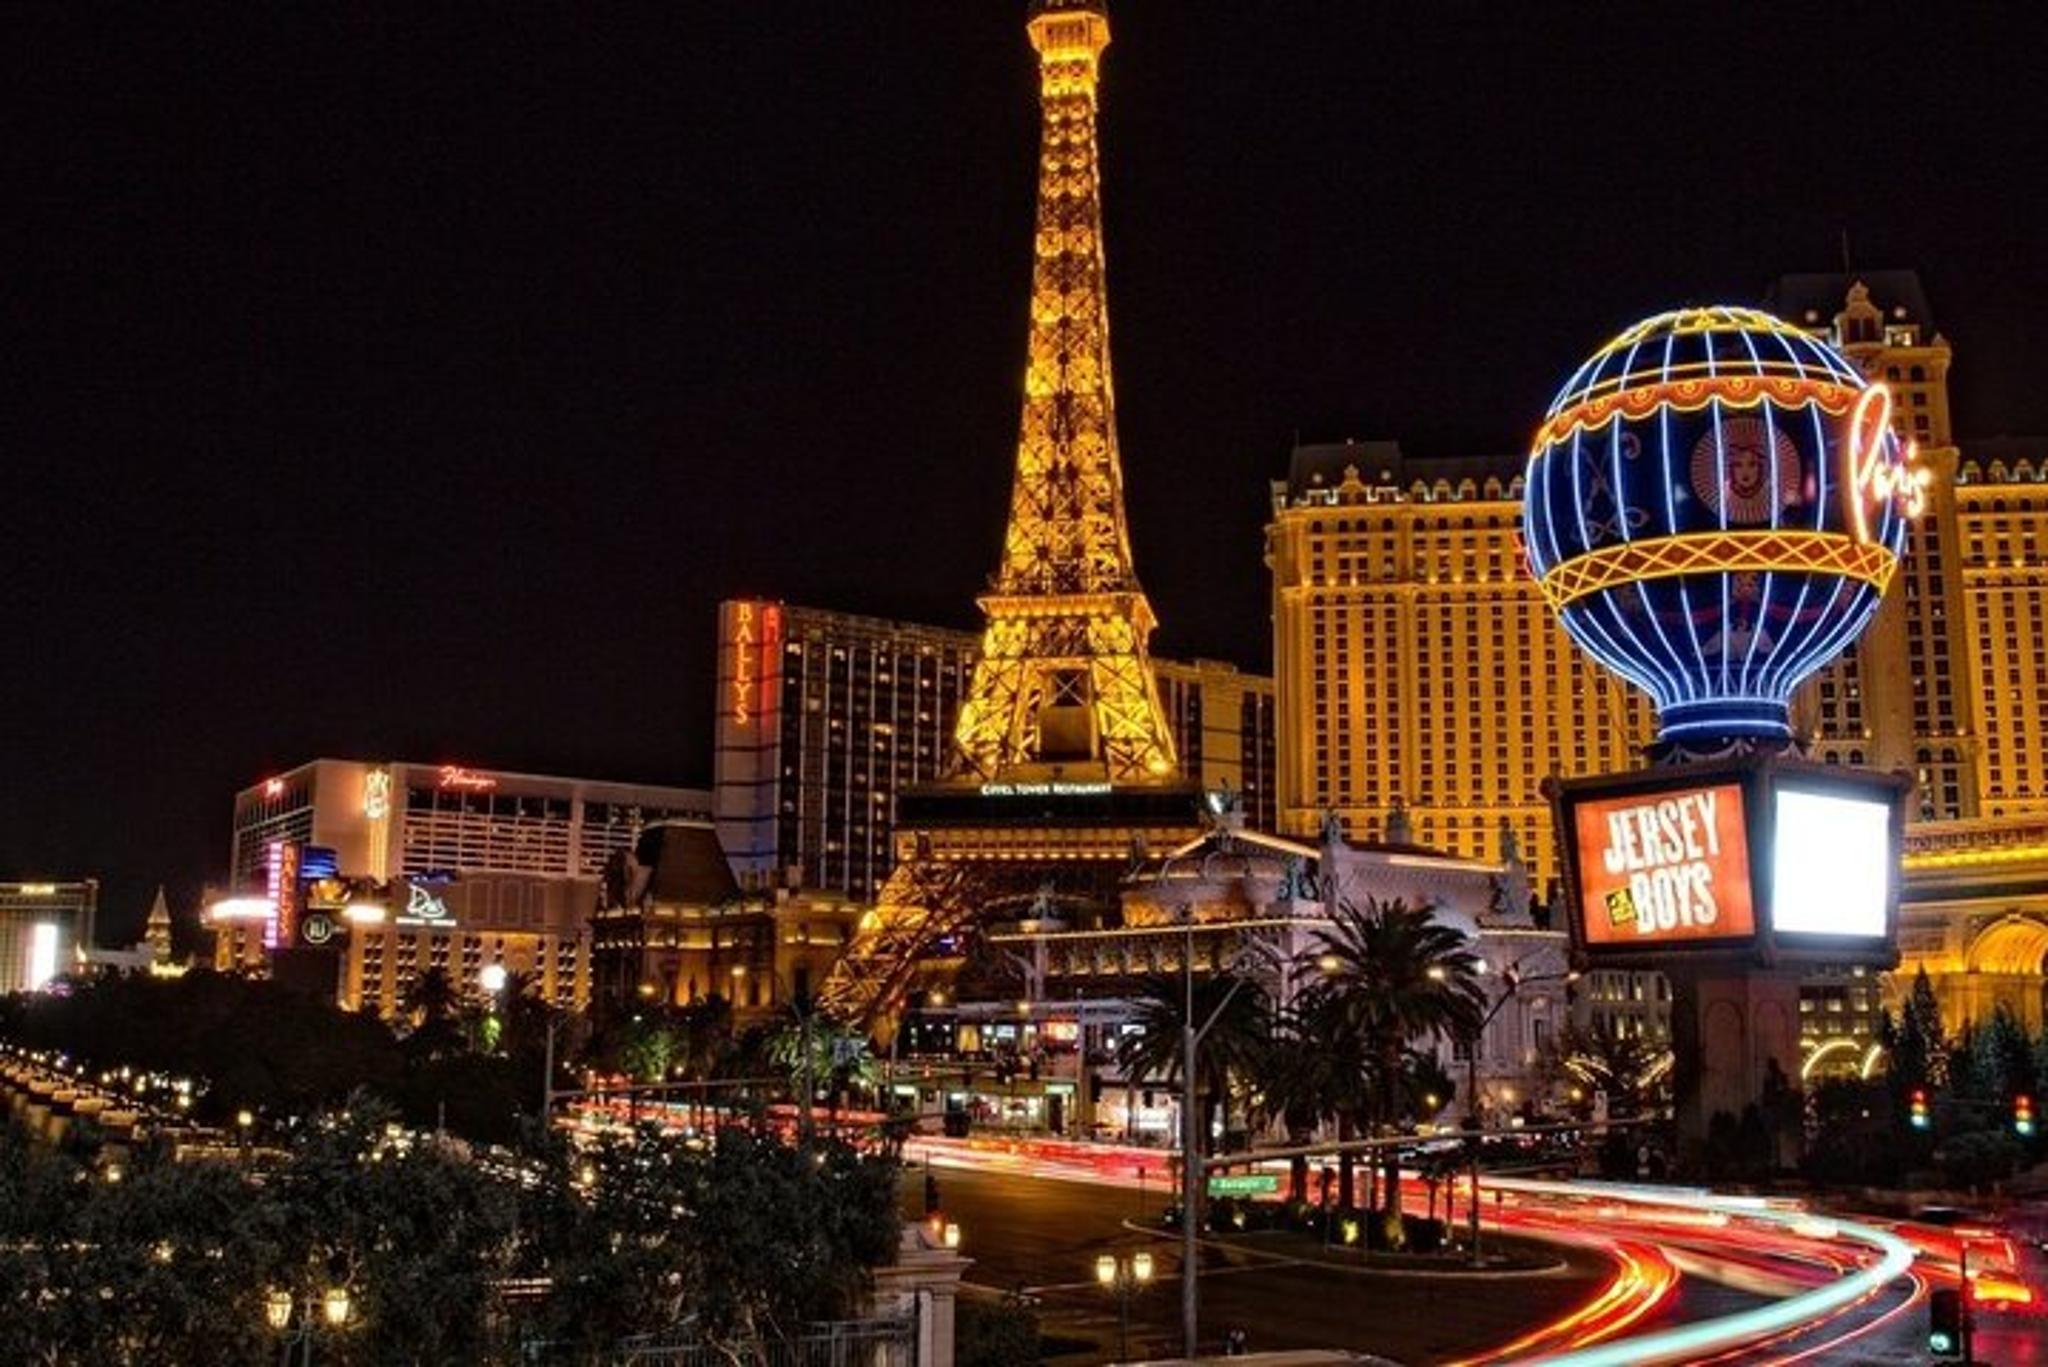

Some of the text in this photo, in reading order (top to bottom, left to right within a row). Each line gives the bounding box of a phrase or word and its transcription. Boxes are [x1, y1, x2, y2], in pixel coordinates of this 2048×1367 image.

[1849, 383, 1931, 544] Paris
[735, 603, 753, 724] BALLYS
[1603, 790, 1720, 875] JERSEY
[1629, 861, 1719, 935] BOYS
